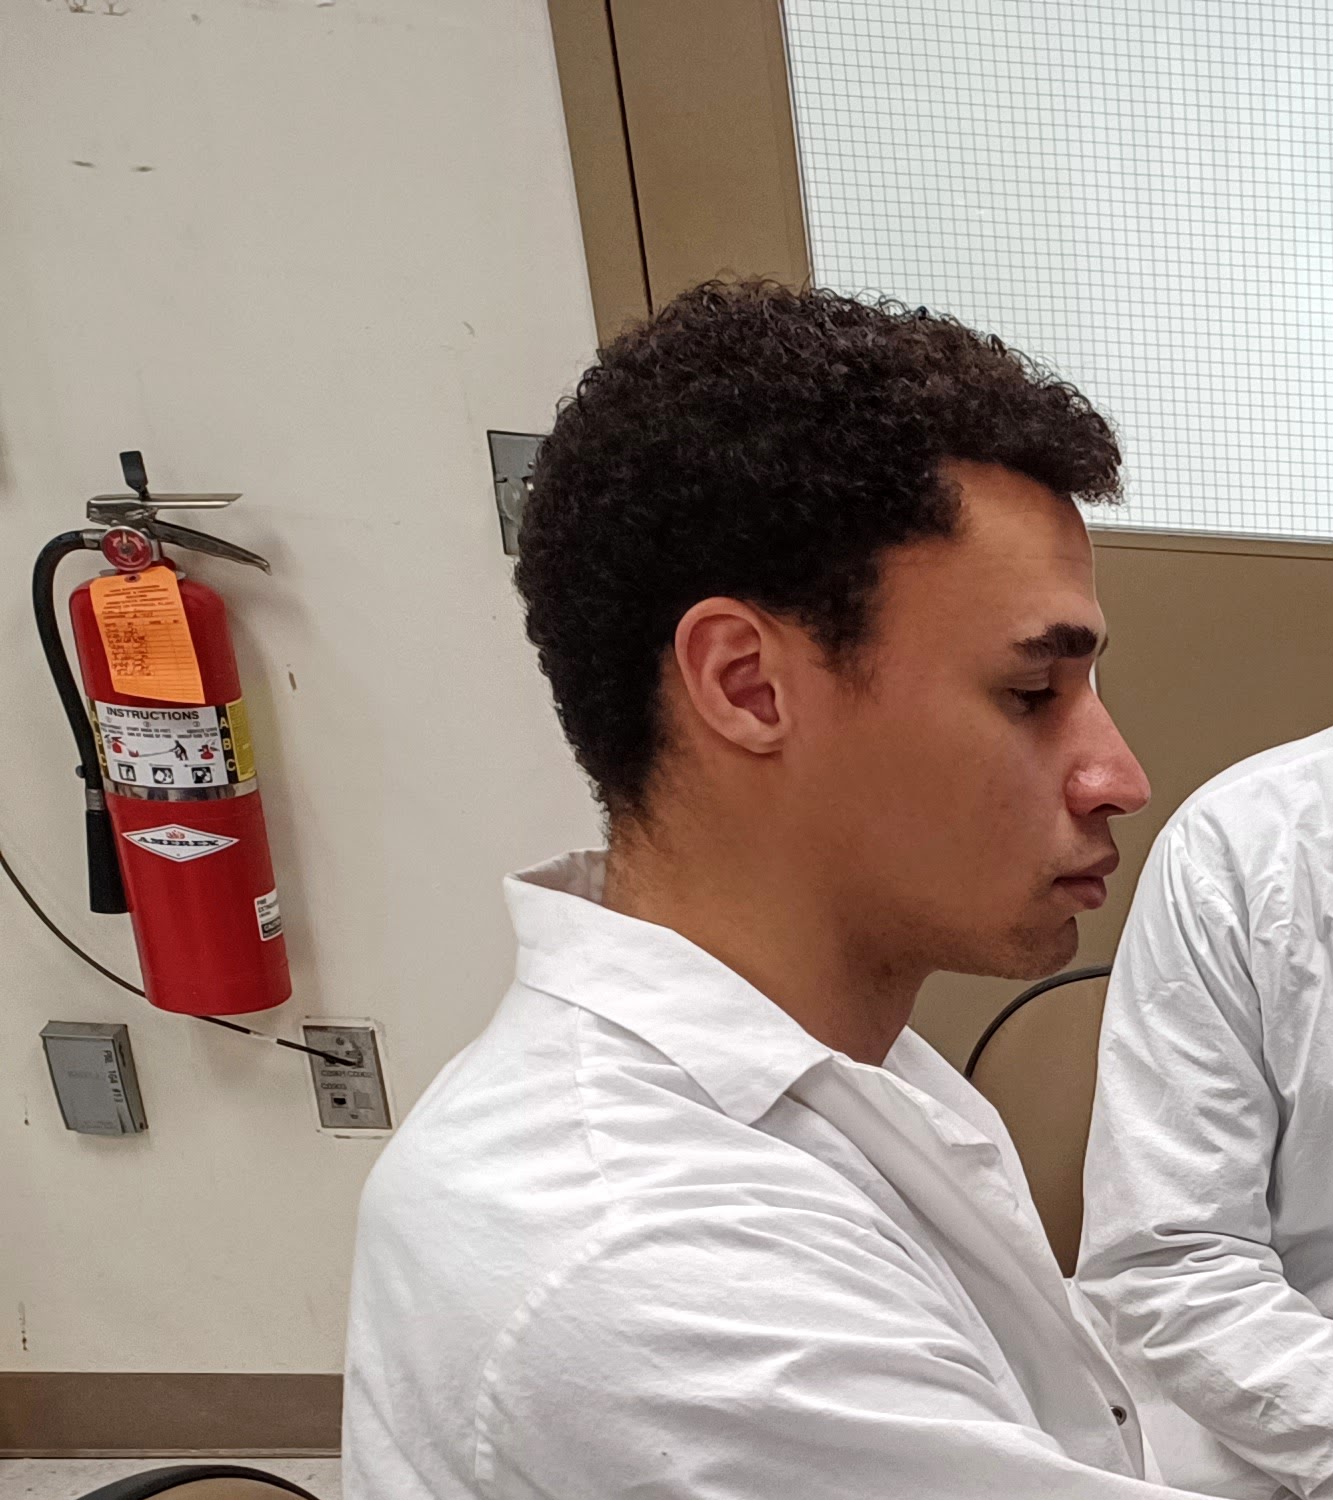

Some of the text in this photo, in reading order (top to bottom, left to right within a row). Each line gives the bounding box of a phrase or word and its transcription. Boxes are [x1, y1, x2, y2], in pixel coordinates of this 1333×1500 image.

[106, 706, 200, 721] INSTRUCTIONS
[219, 716, 229, 728] A
[222, 738, 232, 750] B
[226, 759, 236, 771] C
[137, 836, 220, 847] AMEREX
